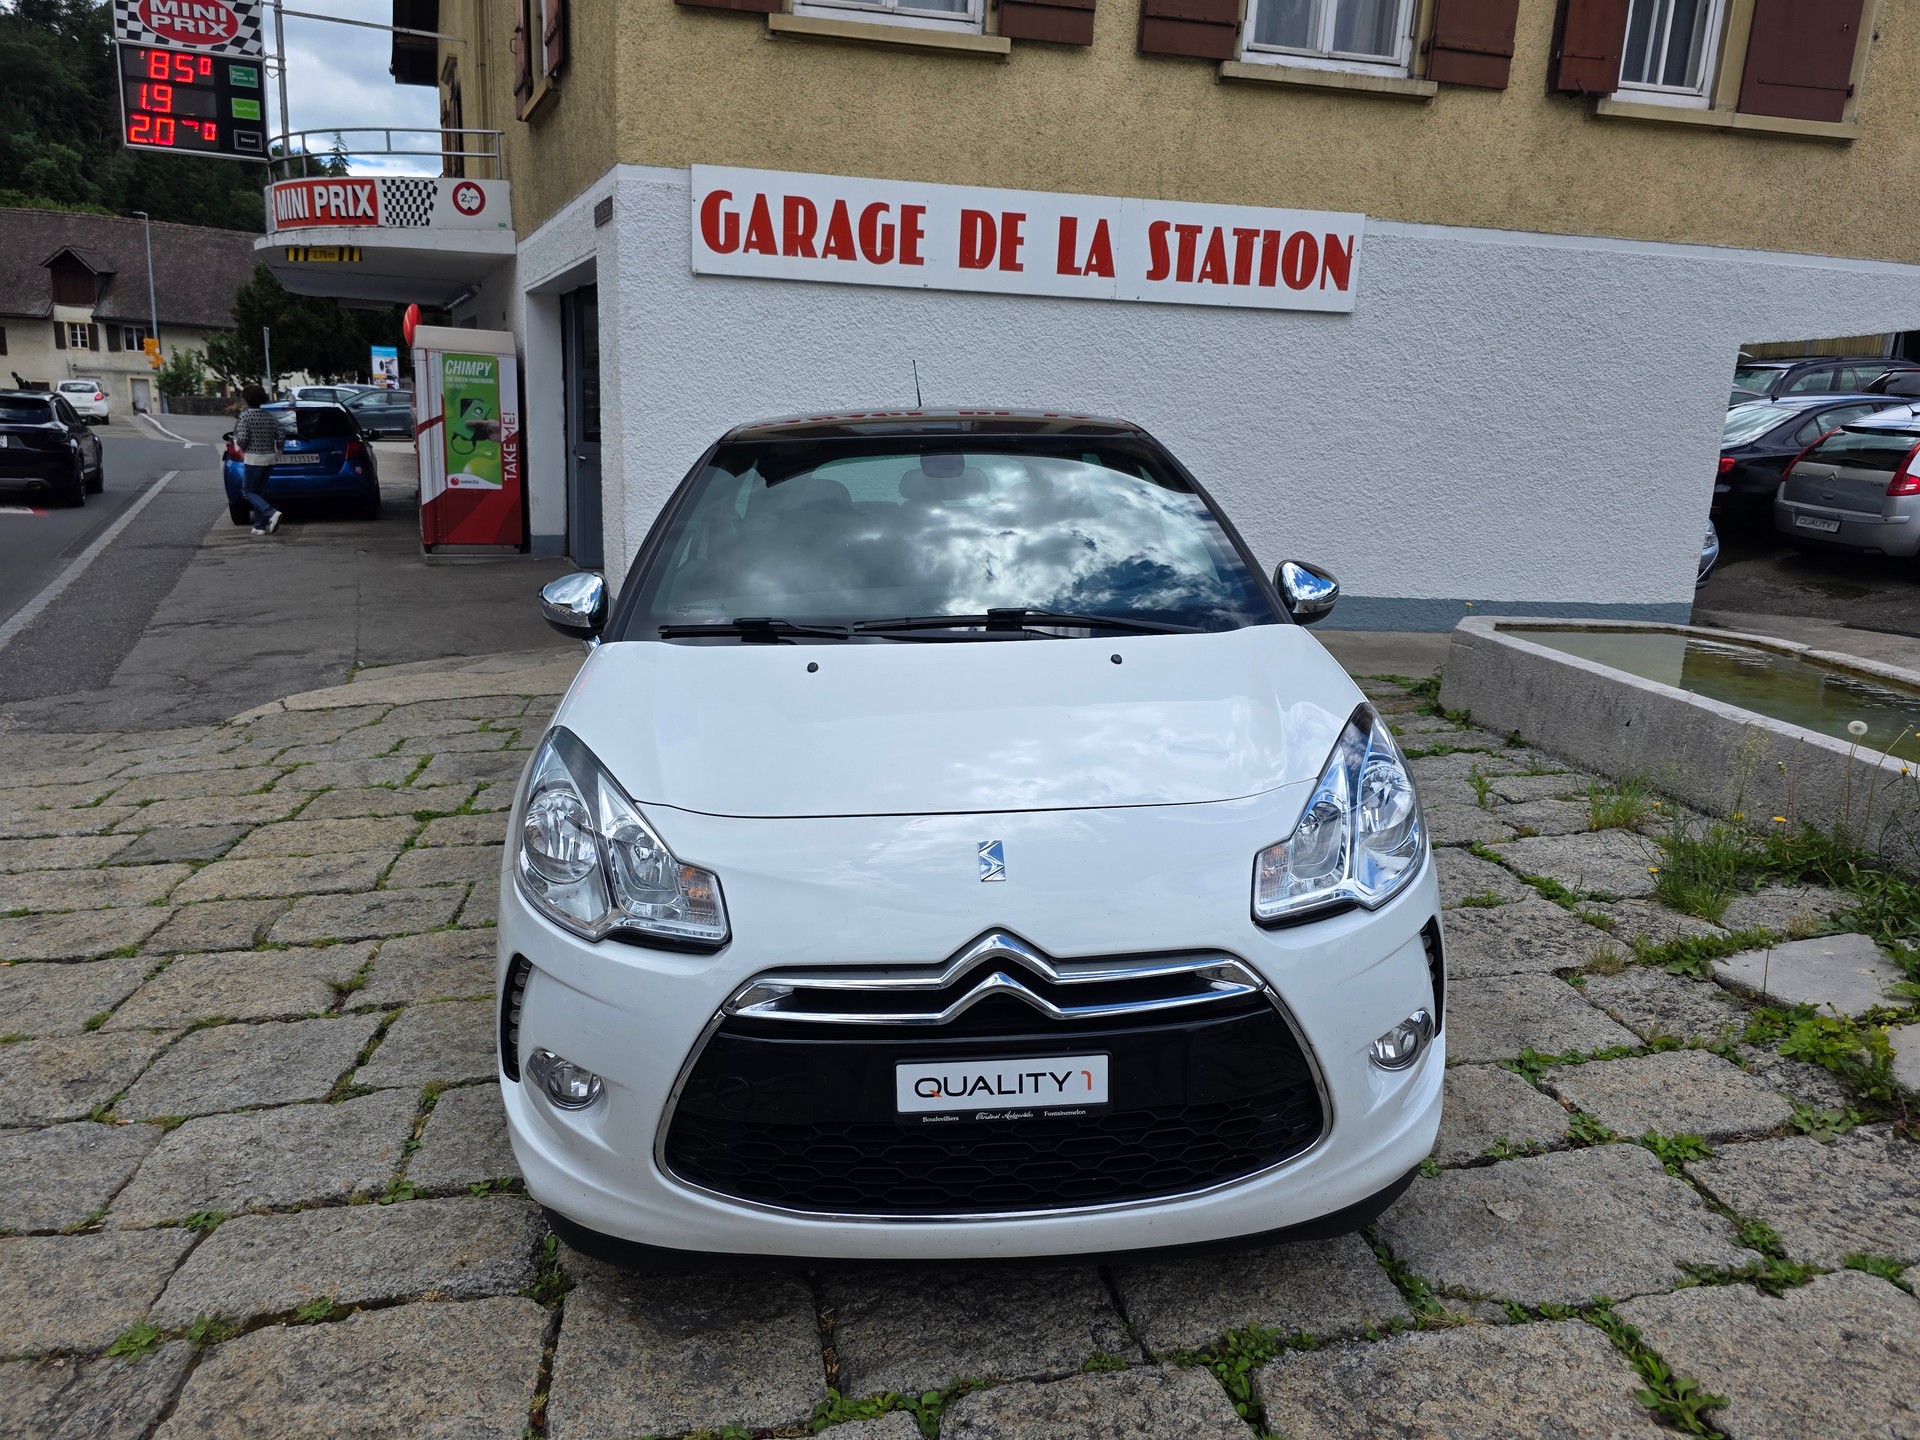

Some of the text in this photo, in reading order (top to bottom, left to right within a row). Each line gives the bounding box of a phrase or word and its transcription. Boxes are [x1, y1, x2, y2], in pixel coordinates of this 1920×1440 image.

[150, 0, 227, 22] MINI
[150, 15, 229, 38] PRIX
[276, 184, 375, 221] MINI PRIX
[700, 189, 1355, 292] GARAGE DE LA STATION
[445, 359, 493, 377] CHIMPY
[502, 412, 518, 481] TAKE ME!
[1799, 517, 1833, 529] QUALITY
[913, 1070, 1092, 1098] QUALITY 1
[922, 1115, 960, 1123] Boudevilliers
[1044, 1109, 1087, 1118] Fontainemelon
